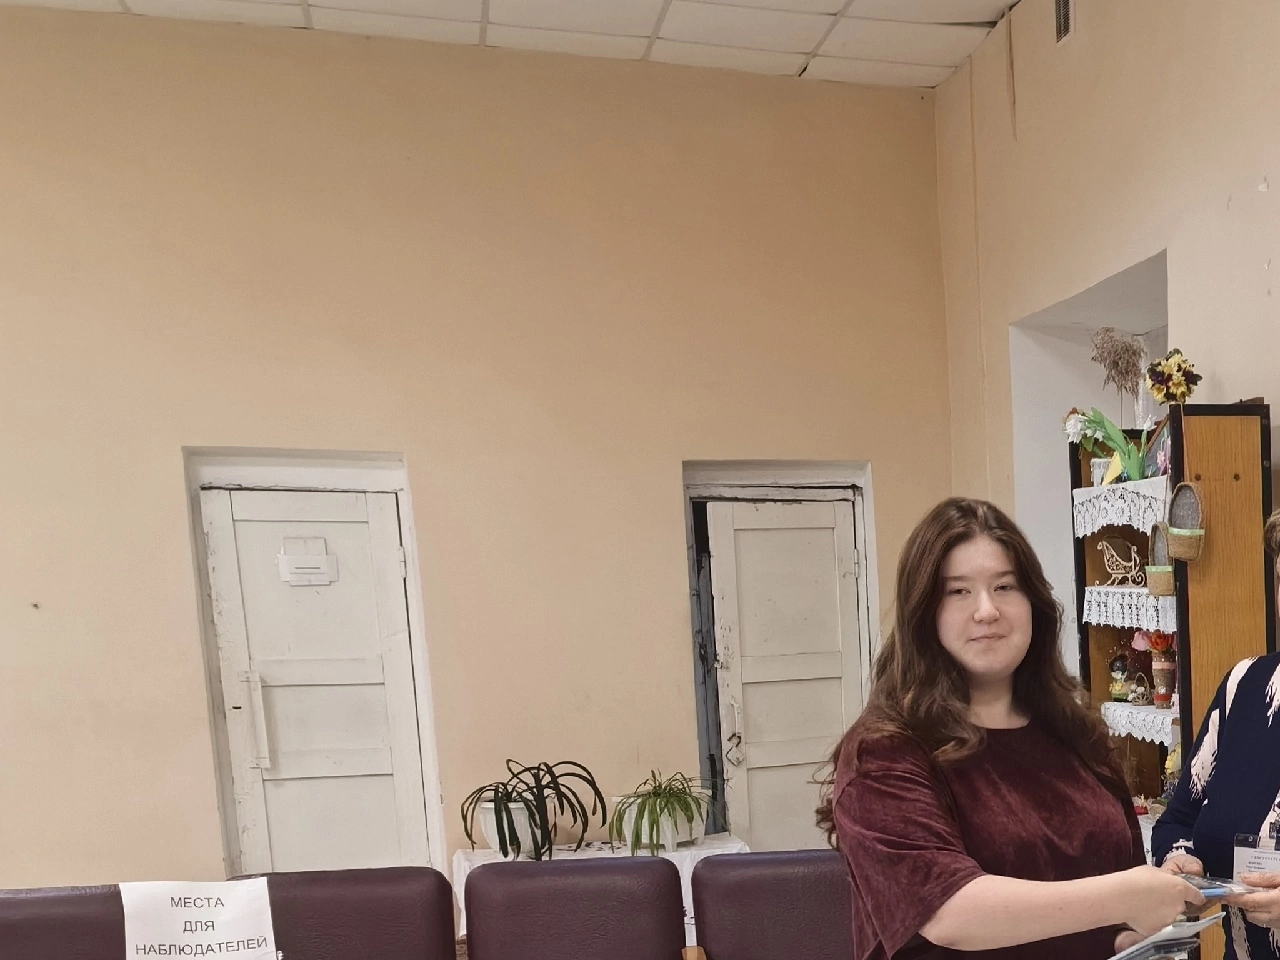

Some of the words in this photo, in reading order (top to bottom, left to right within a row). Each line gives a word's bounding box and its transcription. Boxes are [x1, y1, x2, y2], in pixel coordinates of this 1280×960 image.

[170, 896, 225, 908] МЕСТА
[183, 920, 215, 934] ДЛЯ
[135, 935, 268, 957] НАБЛЮДАТЕЛЕЙ
